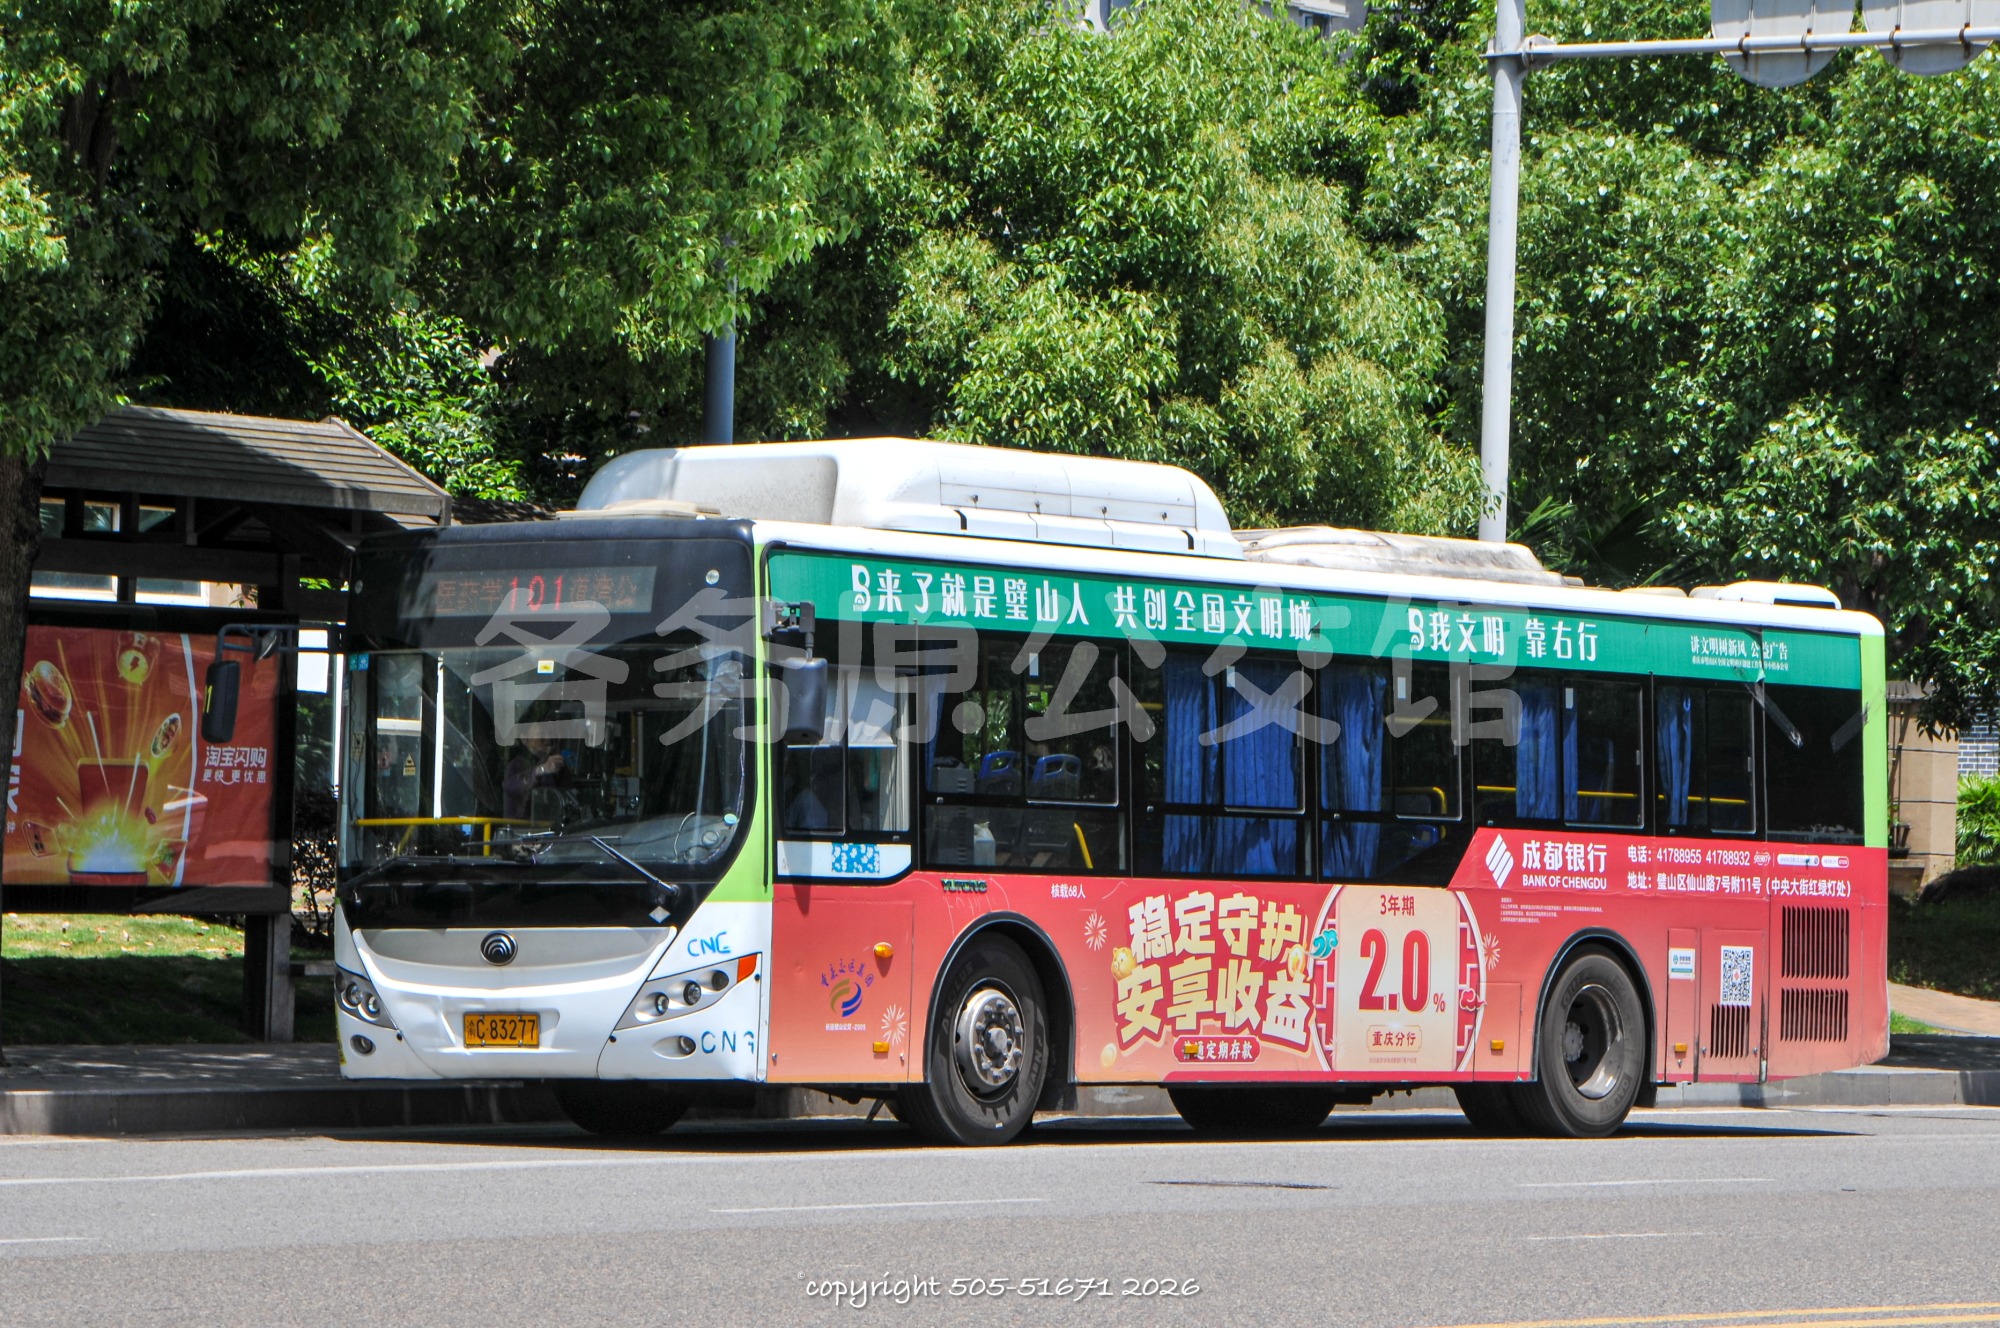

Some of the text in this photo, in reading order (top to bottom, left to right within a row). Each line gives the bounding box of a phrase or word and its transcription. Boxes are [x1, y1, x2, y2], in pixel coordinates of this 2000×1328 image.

[509, 575, 564, 612] 101
[877, 568, 1090, 626] 来了就是璧山人
[1113, 586, 1313, 642] 共创全国文明城
[1428, 611, 1506, 657] 我文明
[1524, 618, 1598, 662] 靠右行
[1690, 635, 1747, 657] 讲文明树新风
[204, 745, 267, 768] 淘宝闪购
[1522, 839, 1607, 873] 成都银行
[1706, 850, 1751, 866] 41788932
[1051, 883, 1086, 899] 核载68人
[1523, 874, 1607, 890] BANK OF CHENGDU
[1380, 894, 1415, 916] 3年期
[1128, 890, 1302, 963] 稳定守护
[1358, 927, 1446, 1014] 2.0%
[1116, 956, 1313, 1046] 安享收益
[1372, 1030, 1417, 1047] 重庆分行
